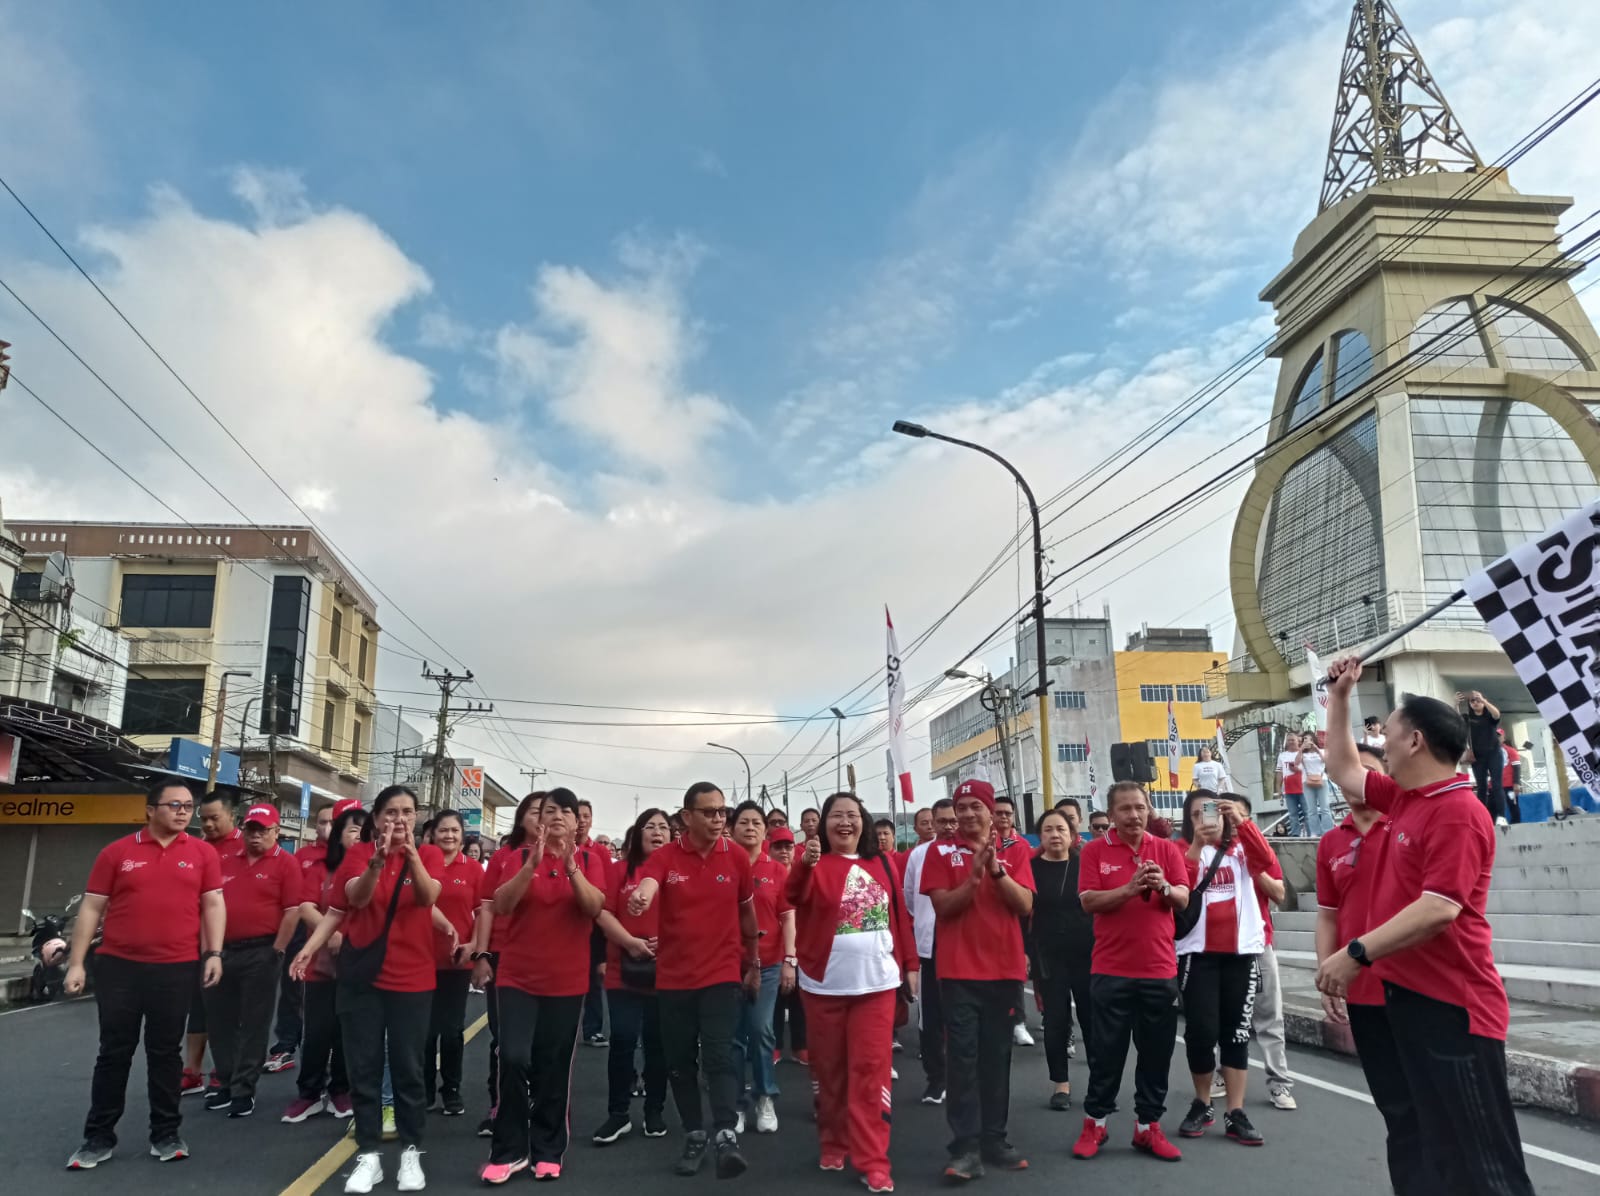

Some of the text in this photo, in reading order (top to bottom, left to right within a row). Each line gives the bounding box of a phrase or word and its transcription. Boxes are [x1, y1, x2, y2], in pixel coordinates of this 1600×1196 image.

[461, 787, 481, 797] BNI
[961, 784, 971, 794] H
[0, 797, 74, 816] ealme
